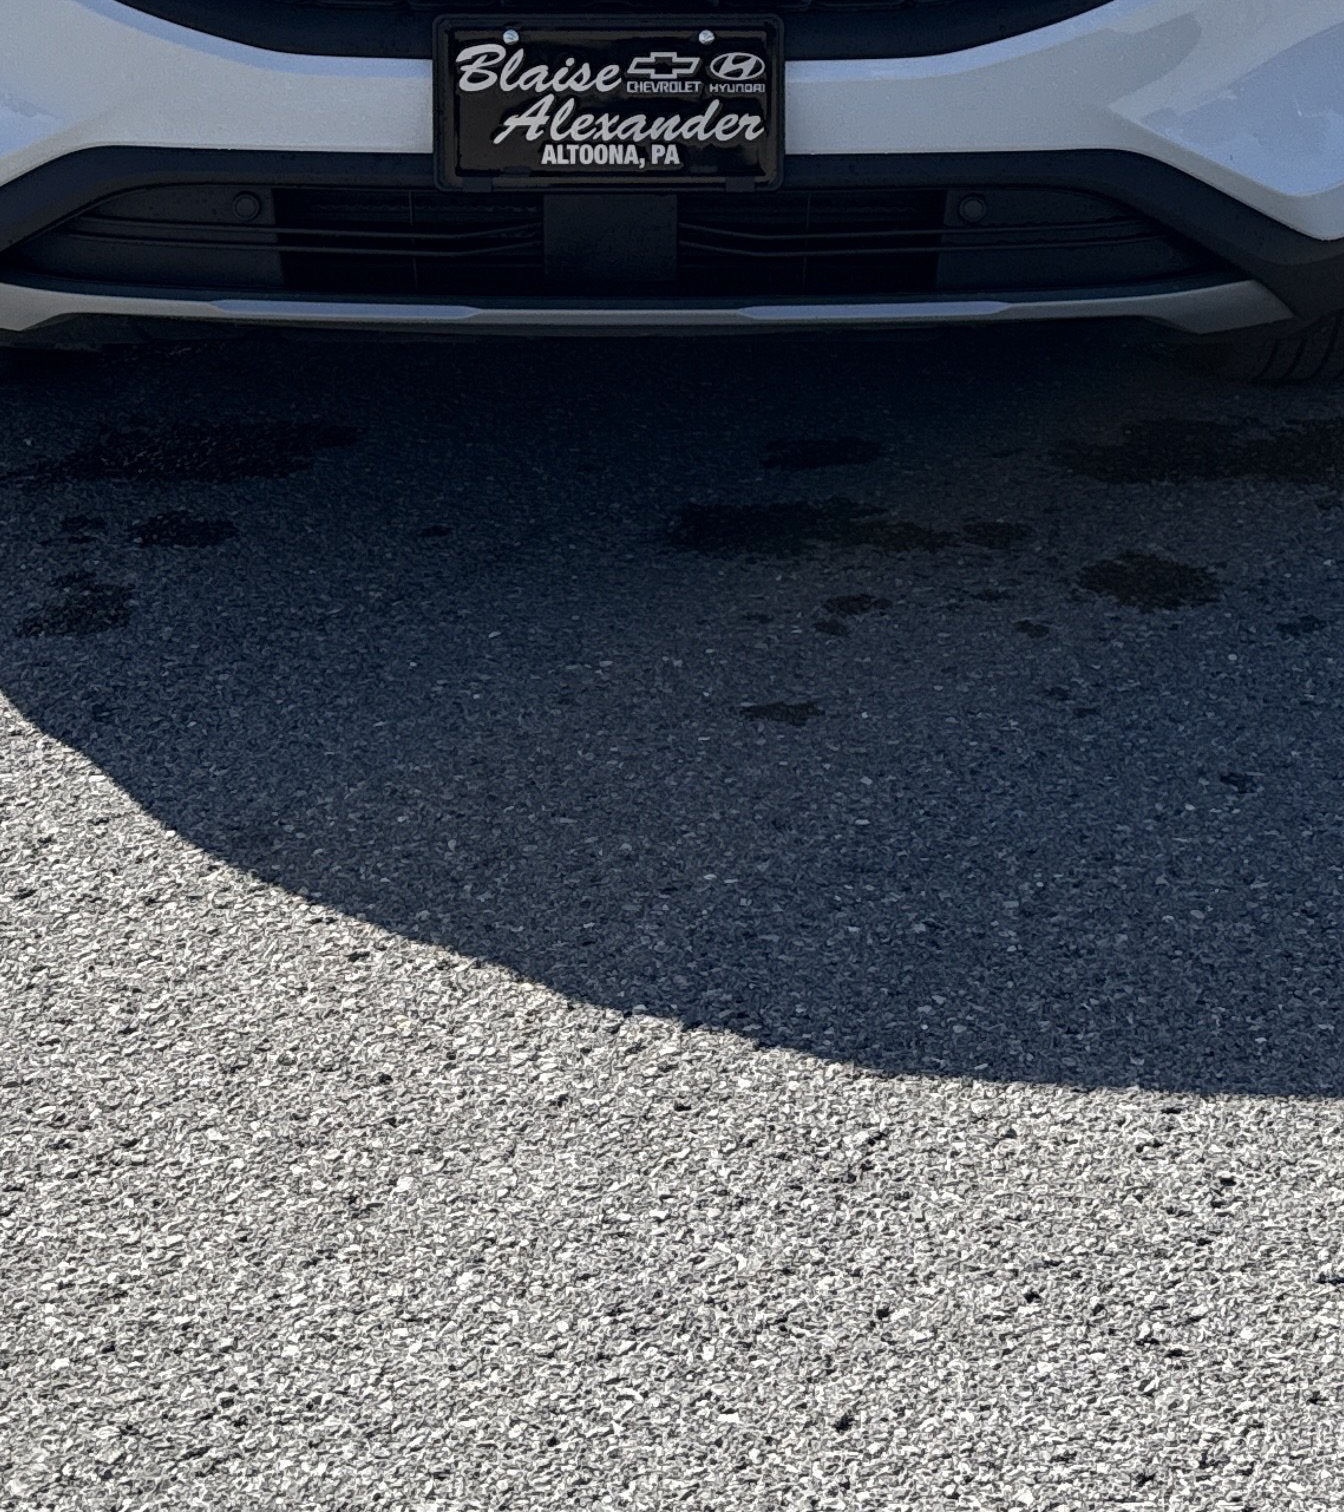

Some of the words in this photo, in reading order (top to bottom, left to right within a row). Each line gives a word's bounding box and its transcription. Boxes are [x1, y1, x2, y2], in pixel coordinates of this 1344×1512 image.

[456, 43, 622, 93] Blaise
[626, 80, 700, 93] CHEVROLET
[709, 83, 766, 93] HYUNDAI
[493, 93, 765, 144] Alexander
[541, 144, 646, 168] ALTOONA,
[651, 144, 681, 165] PA
